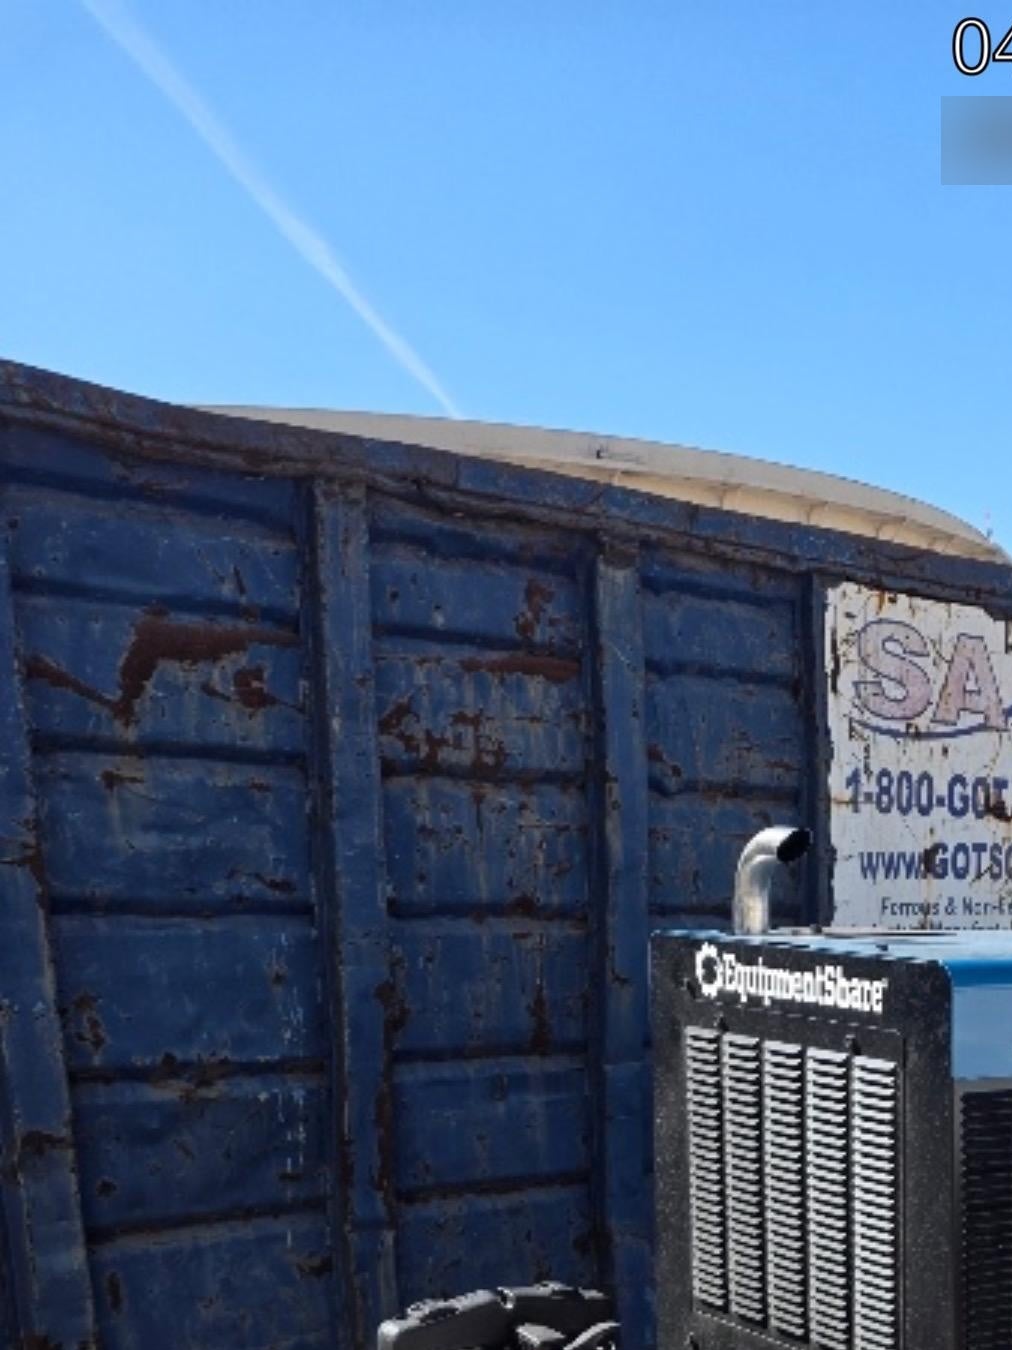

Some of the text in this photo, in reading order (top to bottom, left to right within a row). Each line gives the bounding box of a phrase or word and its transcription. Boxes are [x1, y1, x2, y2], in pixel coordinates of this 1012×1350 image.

[852, 617, 1010, 732] SA
[846, 768, 1009, 818] 1-800-GOT
[722, 953, 885, 1014] EquipmentShare
